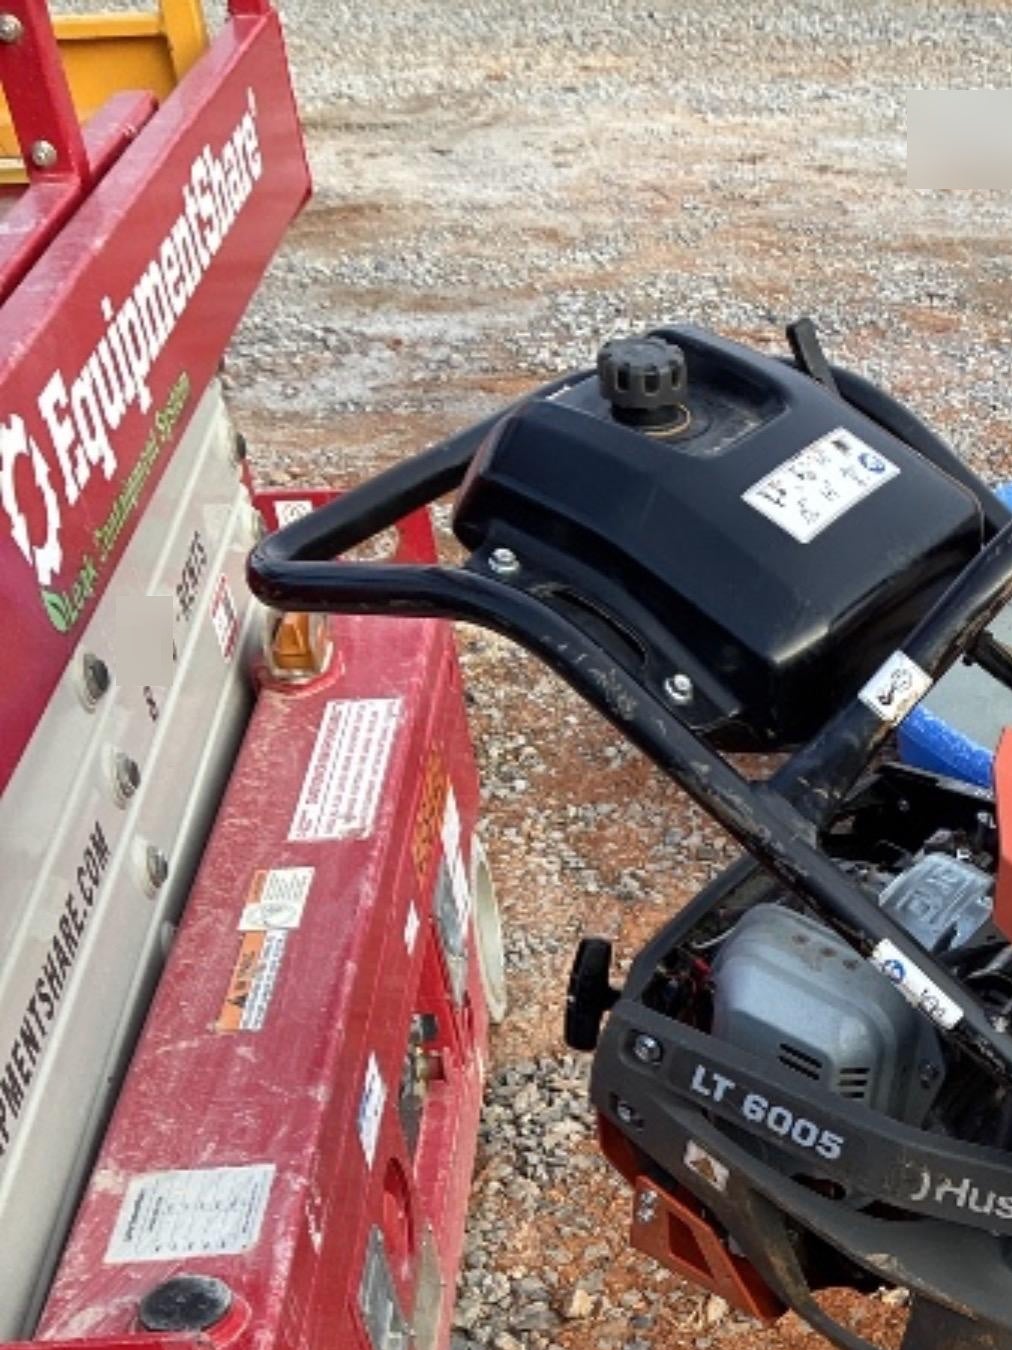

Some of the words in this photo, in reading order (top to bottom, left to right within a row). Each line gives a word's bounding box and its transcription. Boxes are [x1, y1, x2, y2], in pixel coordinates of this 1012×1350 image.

[38, 110, 262, 505] EquipmentShare
[690, 1063, 738, 1103] LT
[742, 1092, 846, 1161] 6005
